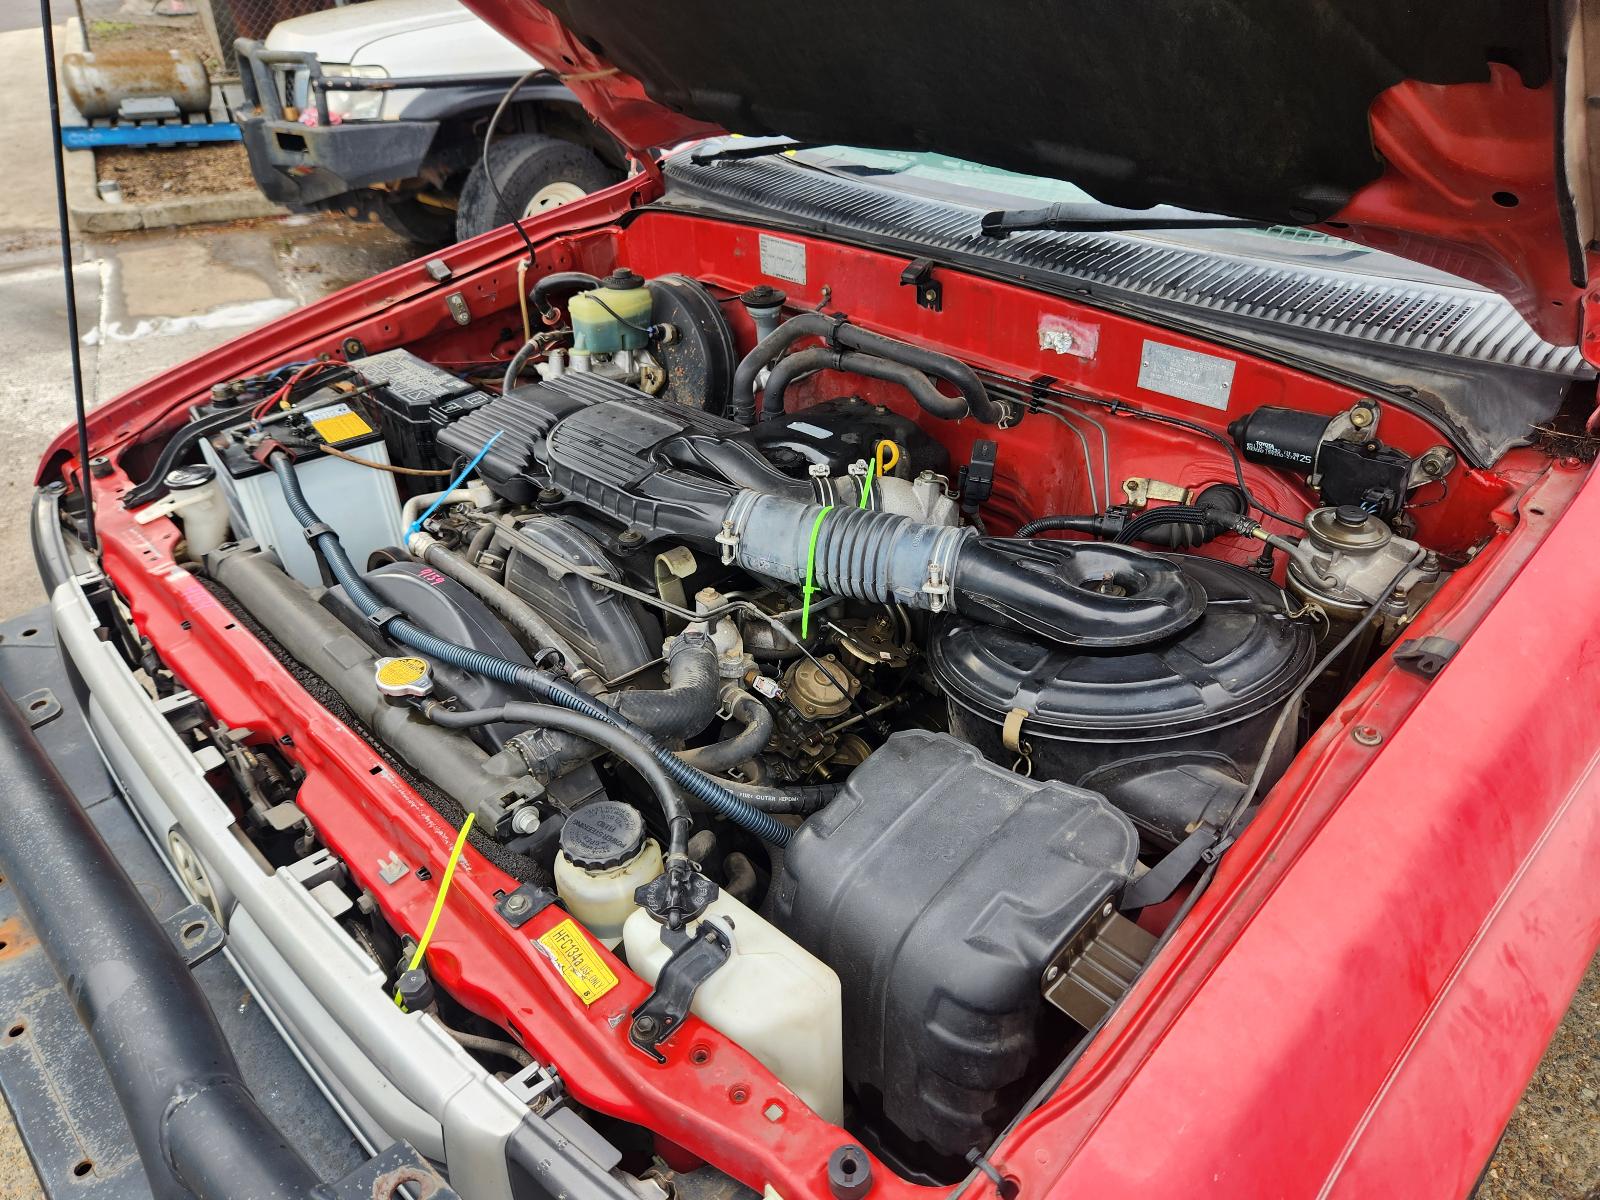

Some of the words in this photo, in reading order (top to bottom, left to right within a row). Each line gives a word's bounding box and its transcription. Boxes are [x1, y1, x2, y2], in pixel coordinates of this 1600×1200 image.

[1255, 440, 1274, 449] TOYOTA
[1299, 455, 1312, 464] 25
[756, 794, 776, 802] OUTER
[596, 820, 616, 833] FLUID
[552, 928, 584, 967] HFC134a
[589, 974, 603, 990] ONLY
